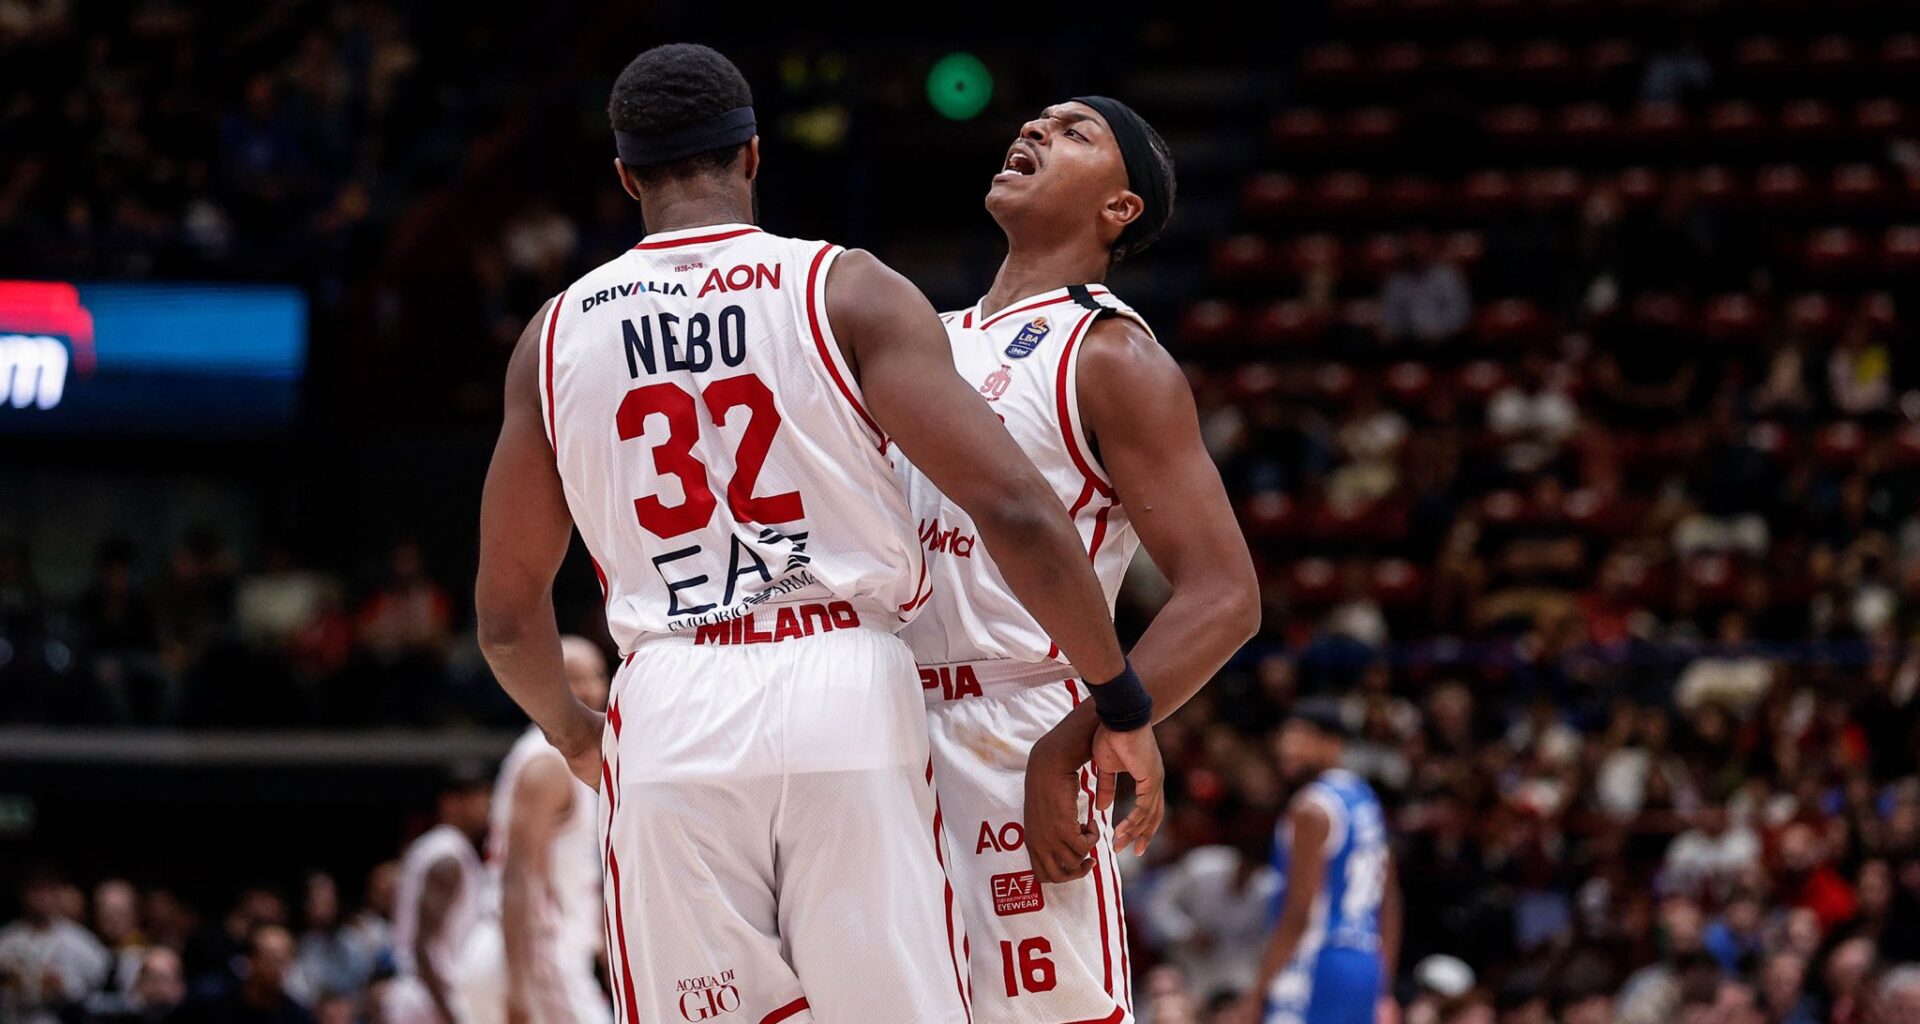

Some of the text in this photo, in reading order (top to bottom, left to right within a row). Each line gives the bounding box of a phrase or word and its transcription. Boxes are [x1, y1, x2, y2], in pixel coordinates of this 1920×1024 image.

[582, 263, 781, 313] DRIVALIA AON
[621, 304, 746, 379] NEBO
[1018, 333, 1039, 344] LBA
[616, 373, 805, 540] 32
[667, 602, 749, 632] EMPORIO
[694, 600, 861, 646] MILANO
[993, 874, 1035, 898] EA7
[997, 899, 1039, 912] EYEWEAR
[676, 969, 735, 991] ACQUA DI
[1000, 936, 1057, 998] 16
